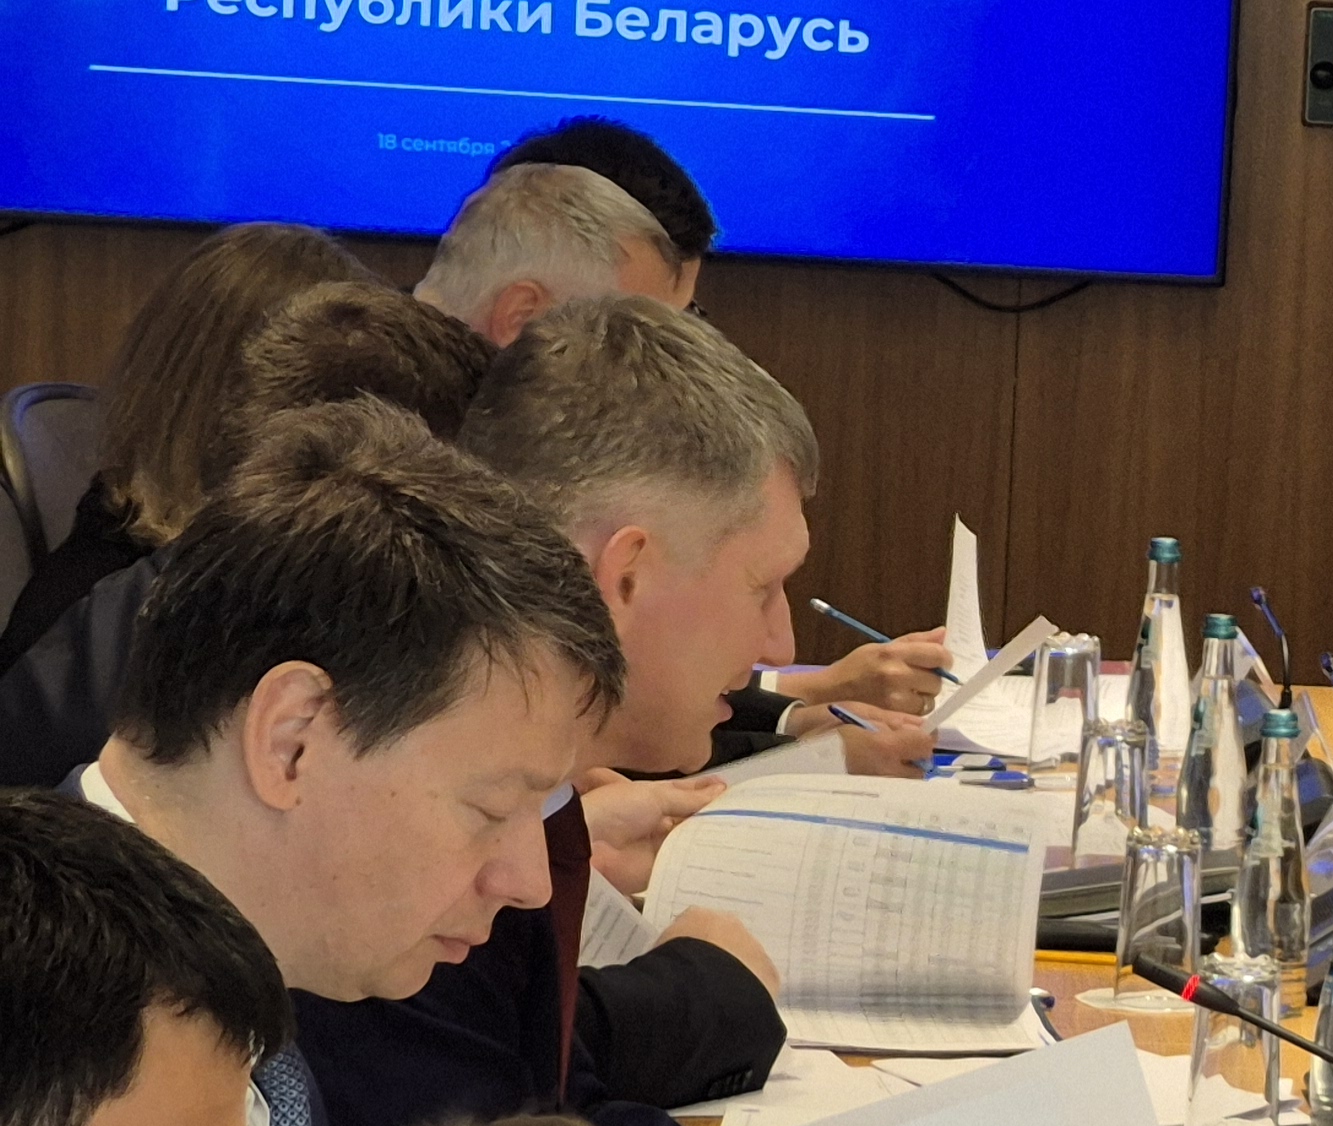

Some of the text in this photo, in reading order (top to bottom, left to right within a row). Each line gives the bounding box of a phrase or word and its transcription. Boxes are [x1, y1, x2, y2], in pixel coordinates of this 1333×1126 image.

[165, 0, 870, 60] спублики Беларусь
[378, 133, 495, 157] 18 сентября
